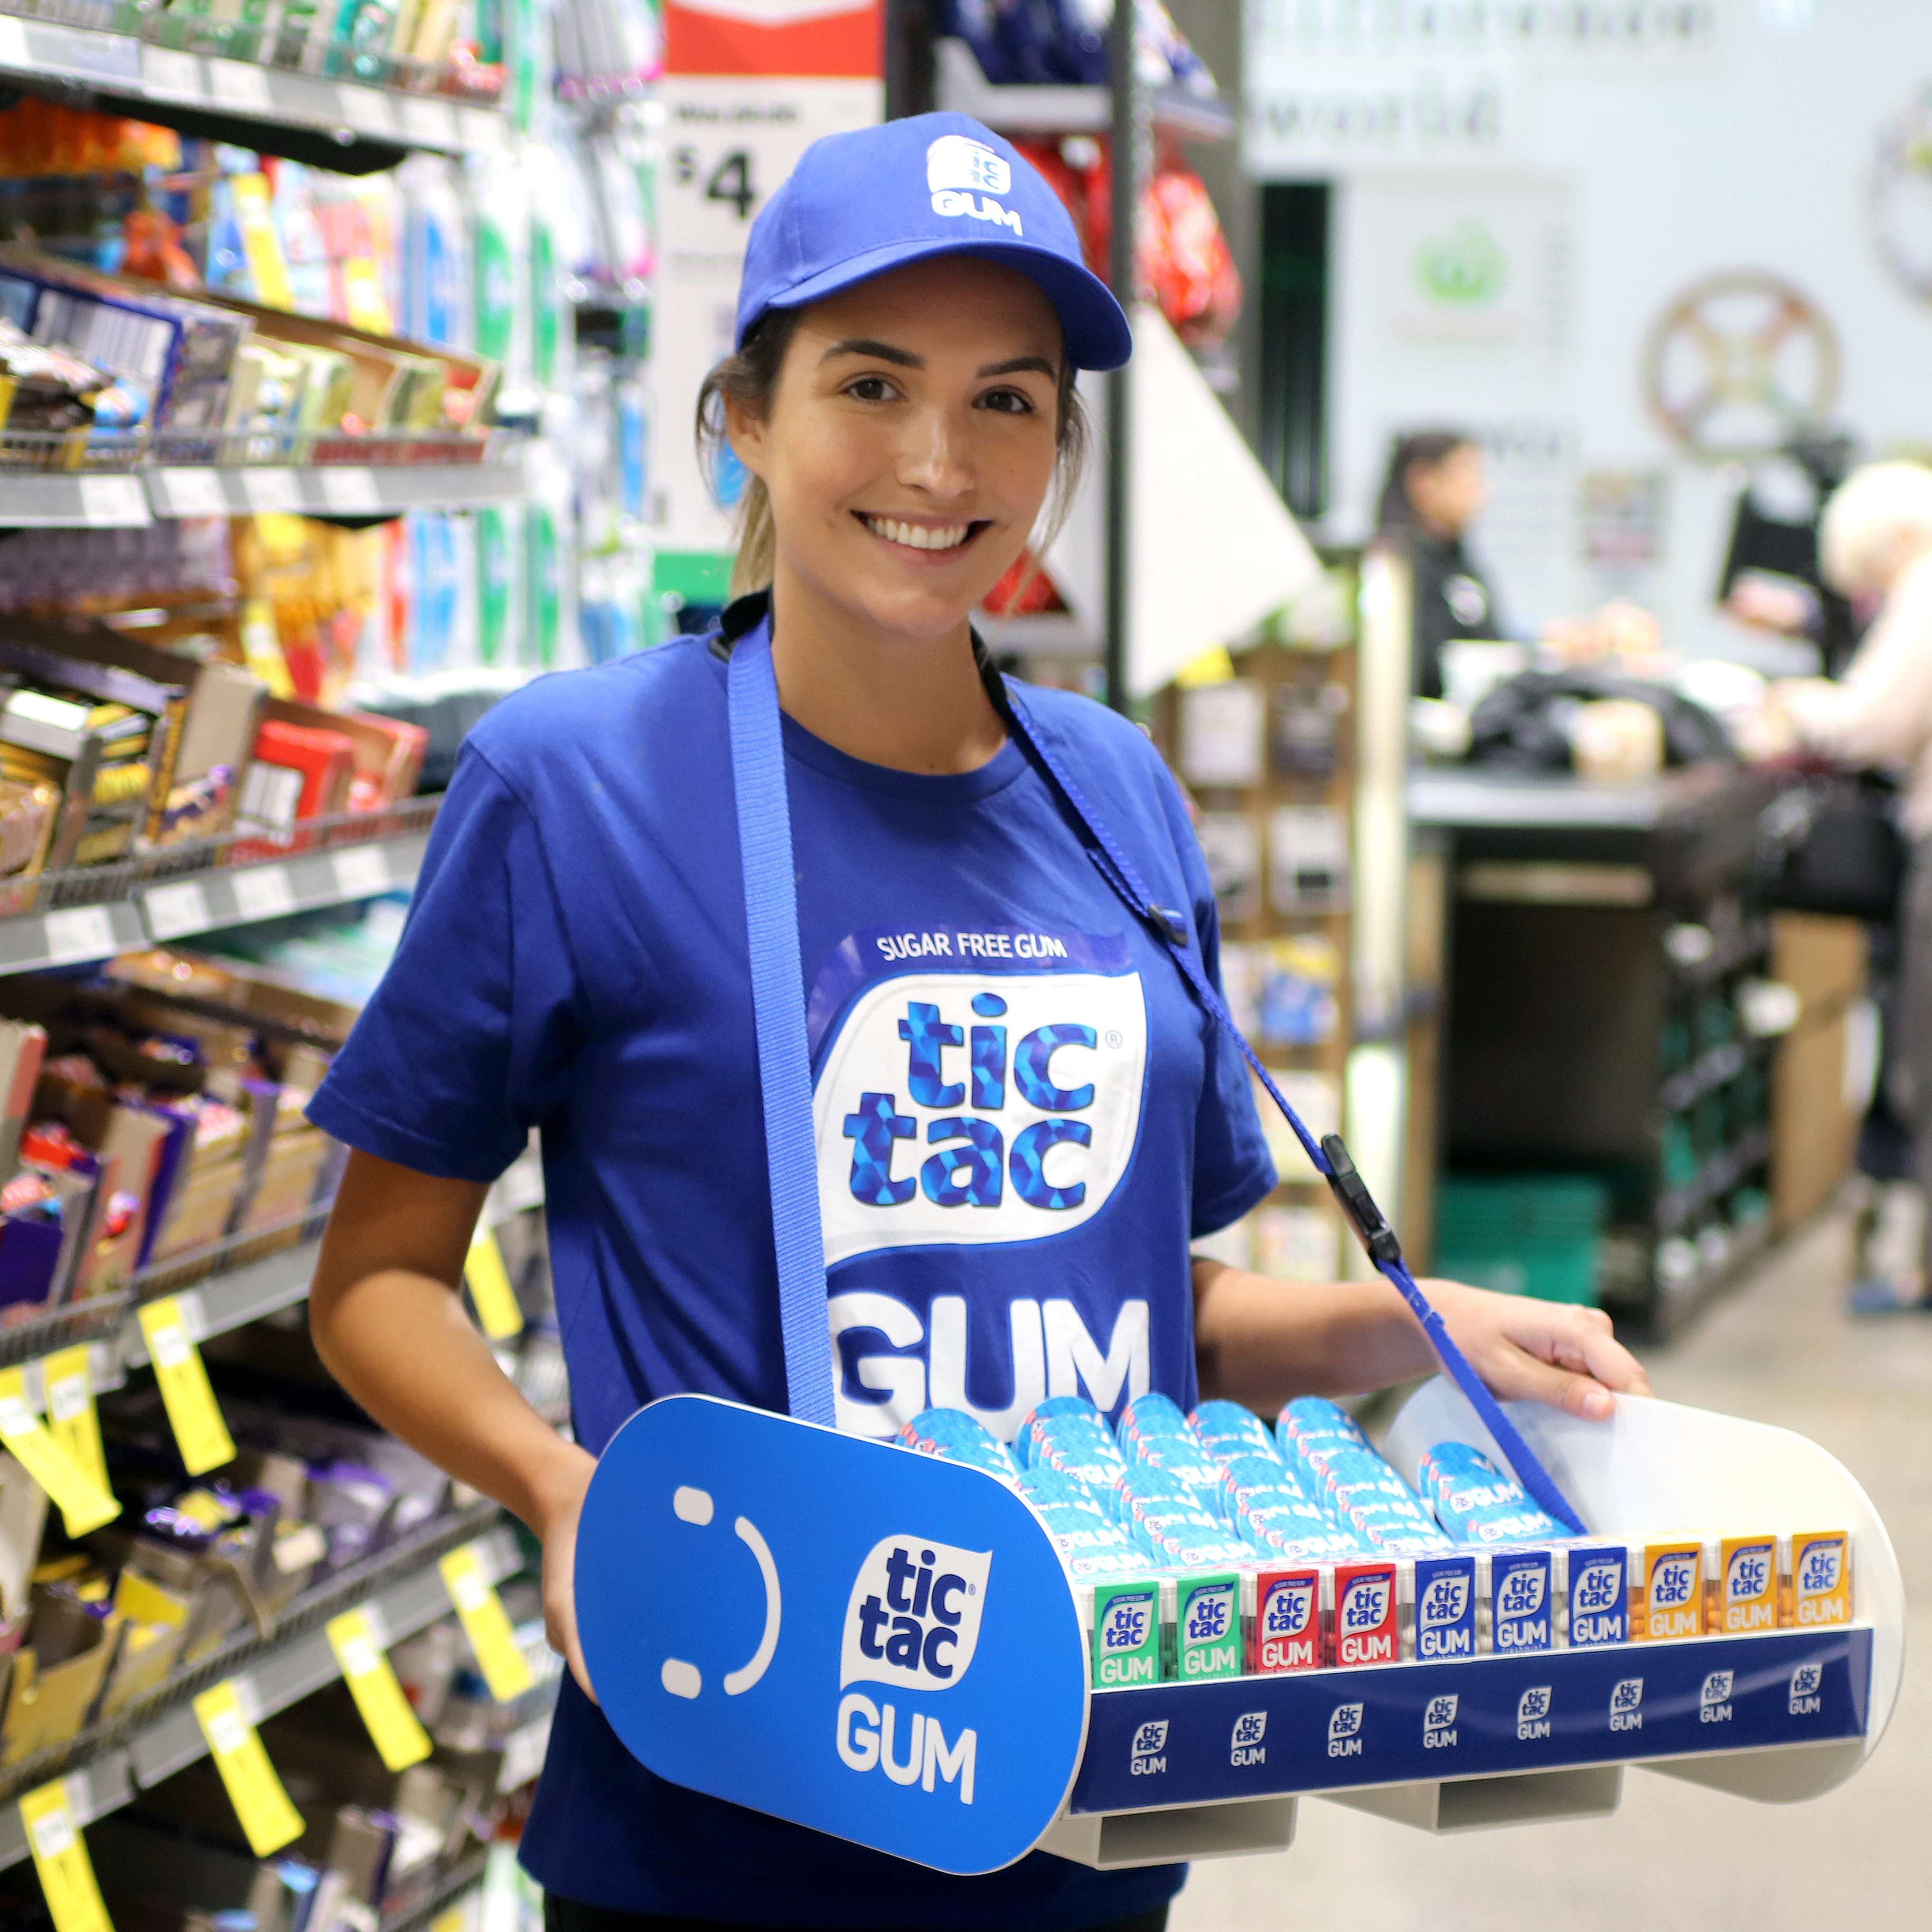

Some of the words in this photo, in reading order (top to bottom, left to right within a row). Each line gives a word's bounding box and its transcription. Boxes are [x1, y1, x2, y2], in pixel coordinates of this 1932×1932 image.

[931, 190, 1024, 237] GUM
[876, 932, 953, 961] SUGAR
[956, 932, 1014, 959] FREE
[1014, 933, 1068, 959] GUM
[898, 992, 1098, 1112] tic
[843, 1092, 1092, 1210] tac
[826, 1291, 1151, 1443] GUM
[1740, 1559, 1765, 1579] tic
[1811, 1553, 1836, 1574] tic
[1511, 1573, 1537, 1595] tic
[1587, 1570, 1614, 1591] tic
[1664, 1565, 1689, 1585] tic
[1804, 1572, 1834, 1590] tac
[886, 1548, 967, 1627] tic
[1434, 1582, 1461, 1603] tic
[1656, 1584, 1688, 1602] tac
[1732, 1578, 1763, 1596] tac
[1277, 1592, 1305, 1614] tic
[1355, 1588, 1382, 1610] tic
[1503, 1593, 1536, 1612] tac
[1579, 1589, 1612, 1607] tac
[1115, 1607, 1145, 1630] tic
[1197, 1598, 1225, 1620] tic
[1347, 1608, 1381, 1627] tac
[1427, 1601, 1460, 1620] tac
[1727, 1603, 1772, 1630] GUM
[1798, 1597, 1844, 1625] GUM
[1189, 1619, 1224, 1638] tac
[1269, 1612, 1303, 1631] tac
[1573, 1615, 1622, 1643] GUM
[1650, 1611, 1697, 1638] GUM
[859, 1595, 958, 1680] tac
[1106, 1628, 1143, 1647] tac
[1420, 1628, 1470, 1656] GUM
[1497, 1620, 1547, 1648] GUM
[1262, 1640, 1314, 1668] GUM
[1341, 1635, 1392, 1663] GUM
[1100, 1656, 1153, 1684] GUM
[1184, 1646, 1236, 1675] GUM
[1339, 1707, 1359, 1722] tic
[1434, 1699, 1455, 1714] tic
[1700, 1704, 1732, 1723] GUM
[1788, 1696, 1821, 1715] GUM
[1242, 1716, 1262, 1731] tic
[1334, 1721, 1356, 1733] tac
[1429, 1712, 1452, 1724] tac
[1610, 1714, 1643, 1732] GUM
[1143, 1724, 1165, 1739] tic
[1236, 1729, 1261, 1742] tac
[1424, 1730, 1458, 1749] GUM
[1517, 1722, 1551, 1741] GUM
[836, 1693, 977, 1806] GUM
[1137, 1738, 1161, 1751] tac
[1328, 1739, 1363, 1758] GUM
[1130, 1757, 1167, 1776] GUM
[1230, 1748, 1266, 1767] GUM
